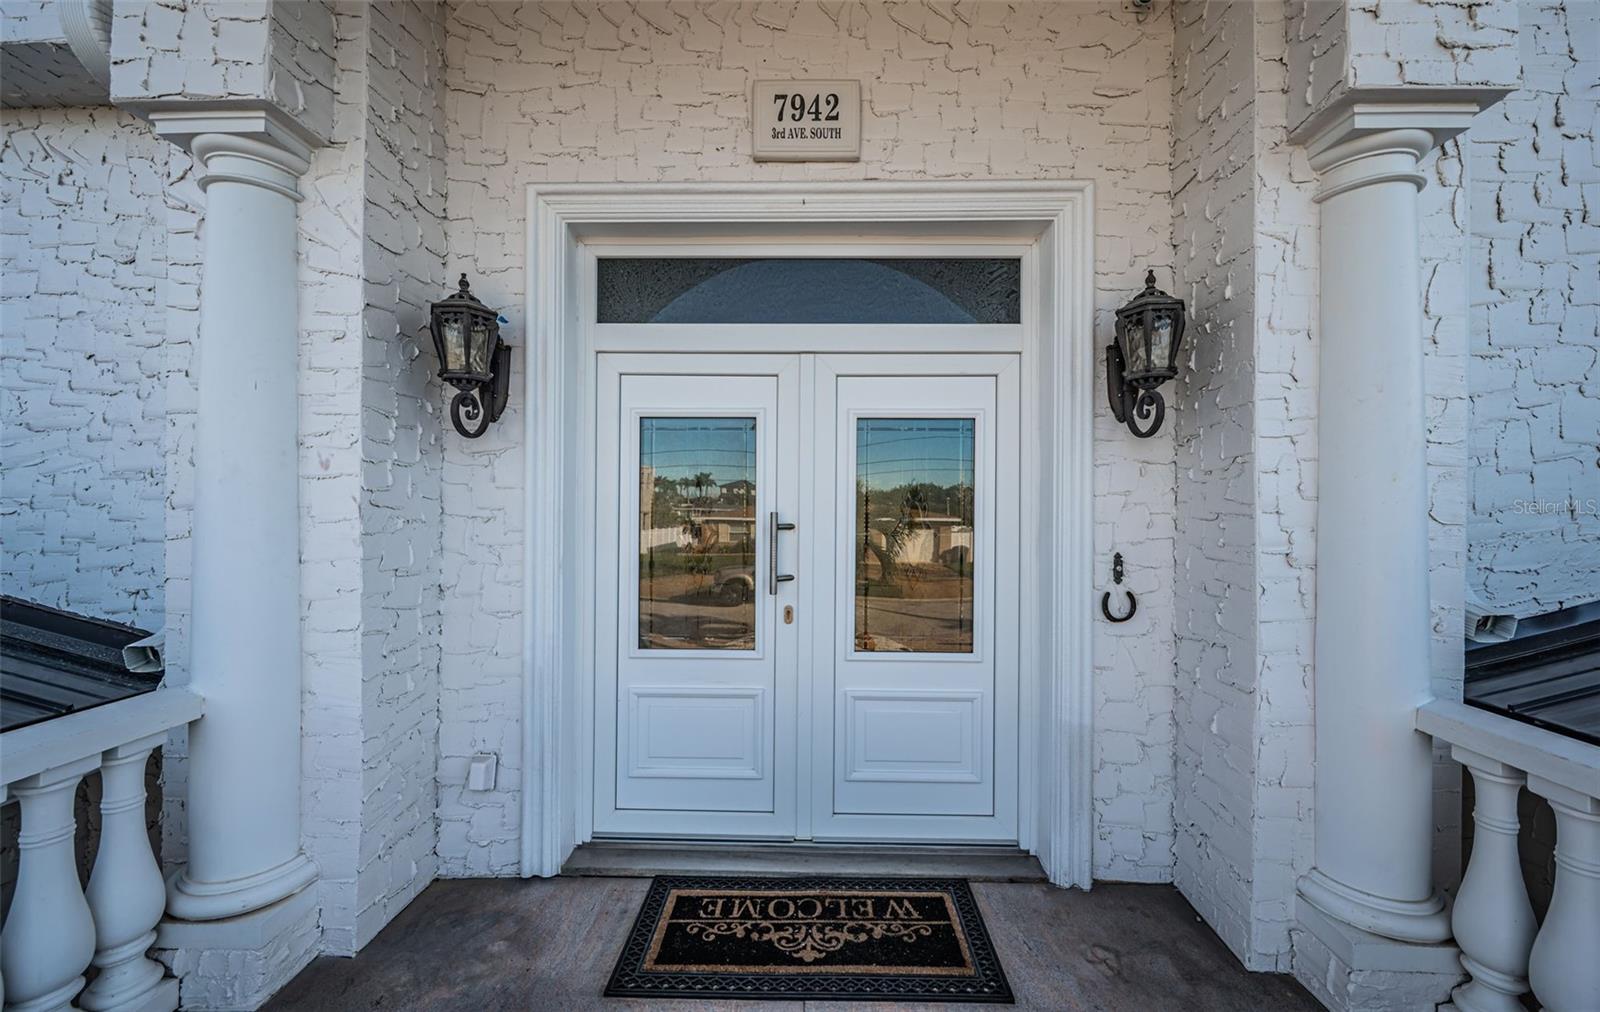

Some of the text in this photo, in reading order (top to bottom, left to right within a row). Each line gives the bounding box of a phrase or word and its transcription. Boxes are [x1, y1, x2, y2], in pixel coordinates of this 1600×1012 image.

[773, 93, 840, 122] 7942
[771, 127, 842, 140] 3rd AVE. SOUTH
[700, 898, 923, 920] WELCOME
